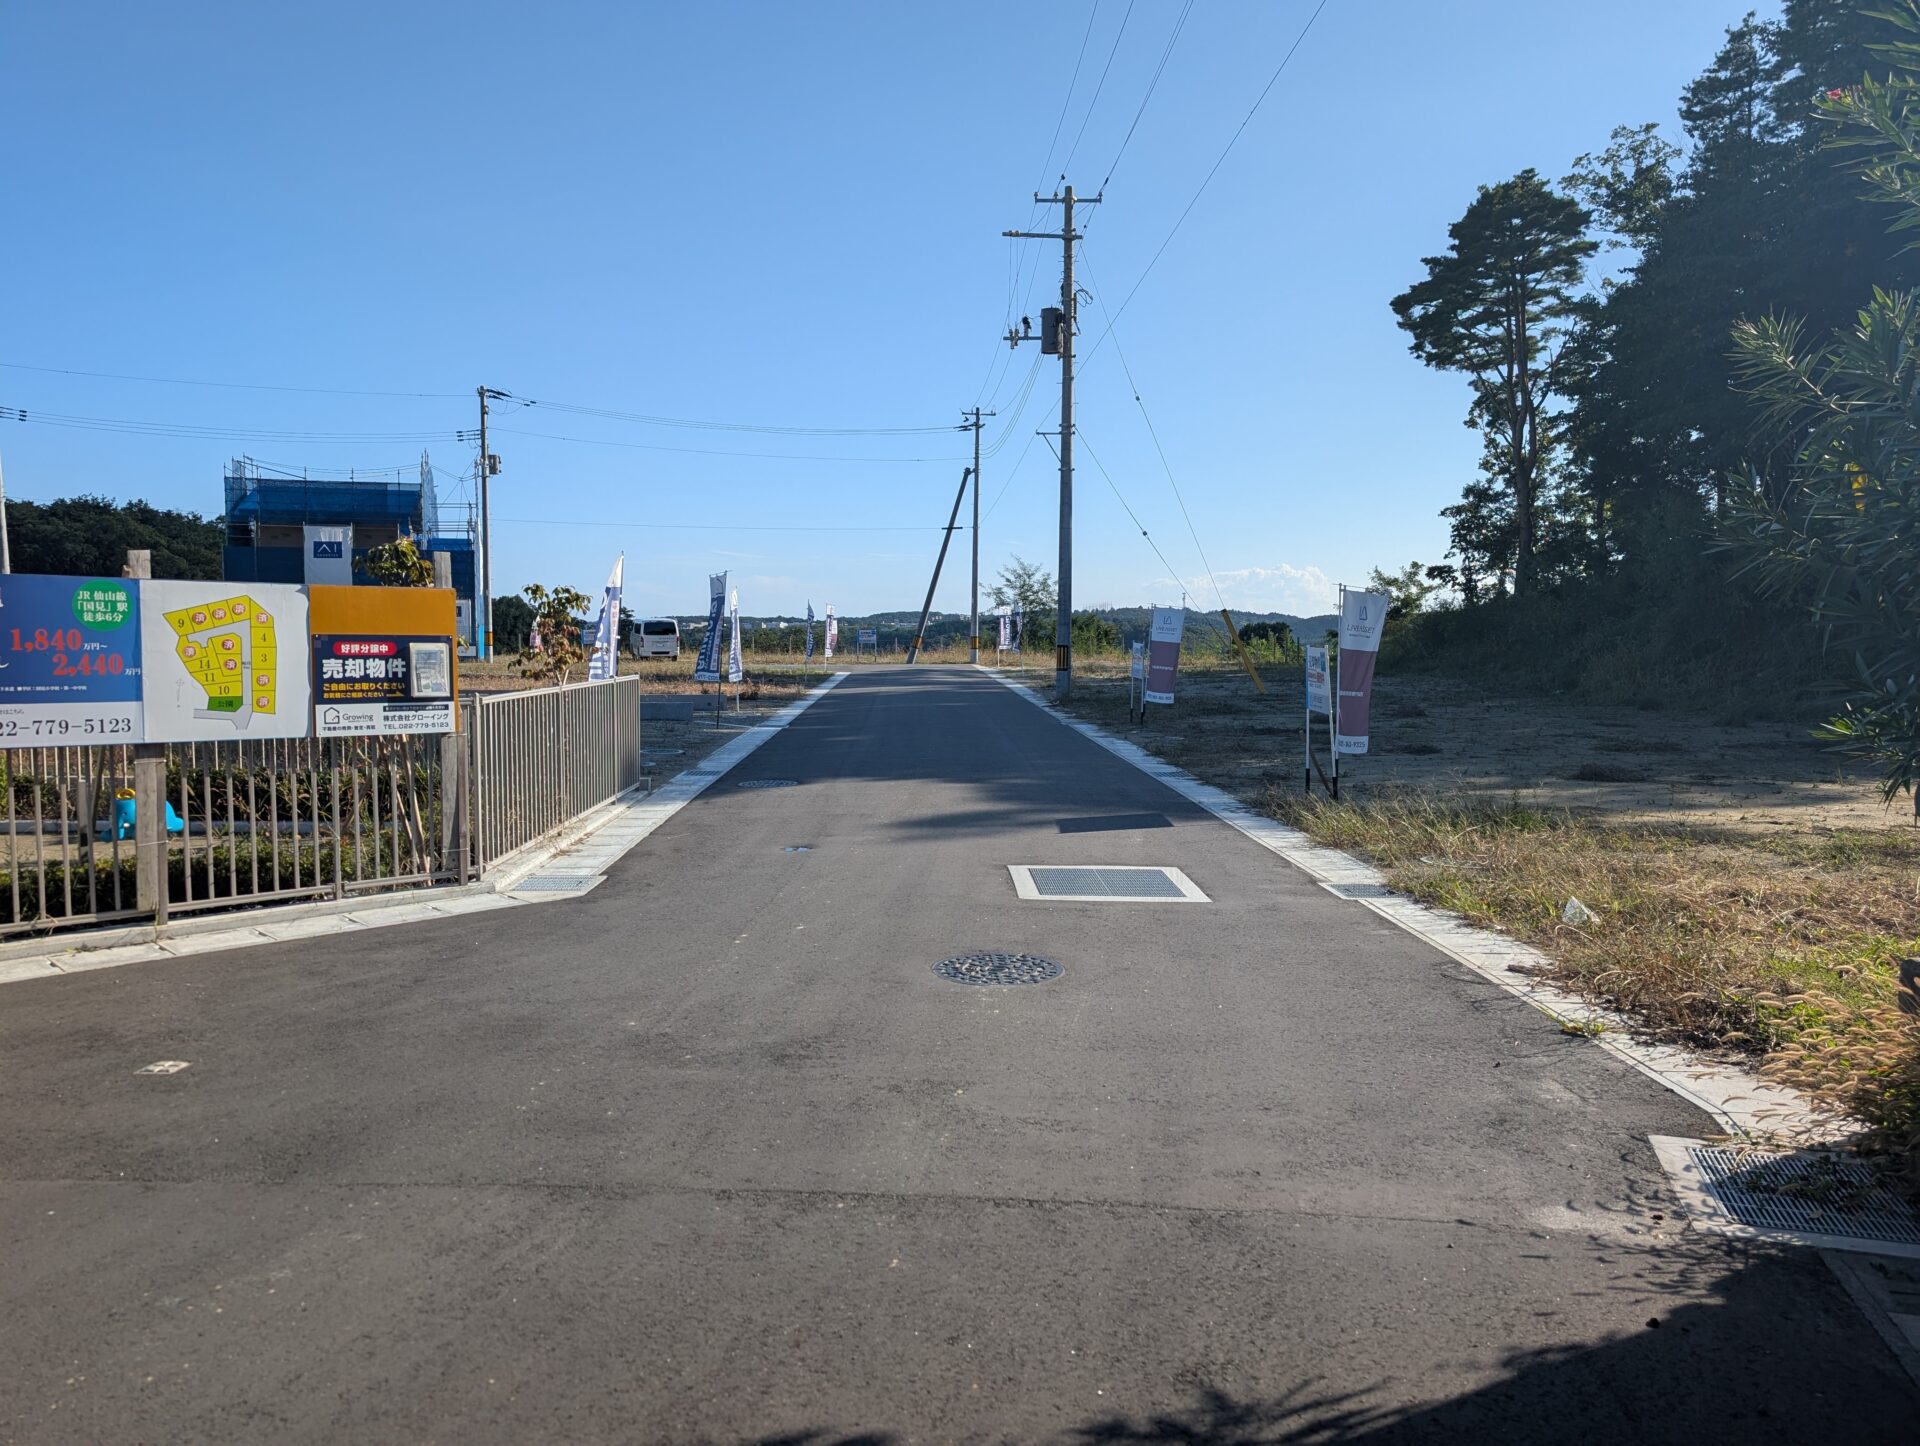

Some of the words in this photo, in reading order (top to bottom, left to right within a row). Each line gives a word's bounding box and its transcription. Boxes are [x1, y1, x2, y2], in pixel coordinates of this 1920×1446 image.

[78, 591, 90, 600] JR
[94, 590, 127, 601] 仙山線
[83, 612, 123, 622] 徒歩6分
[178, 618, 185, 628] 9
[261, 633, 267, 642] 4
[341, 643, 389, 653] 好評分譲中
[261, 653, 267, 663] 3
[200, 660, 211, 669] 14
[322, 658, 406, 679] 売却物件
[205, 673, 216, 682] 11
[219, 686, 230, 695] 10
[323, 682, 405, 691] ご自由にお取りください
[342, 713, 374, 722] Growing
[383, 714, 449, 722] 株式会社グローイング
